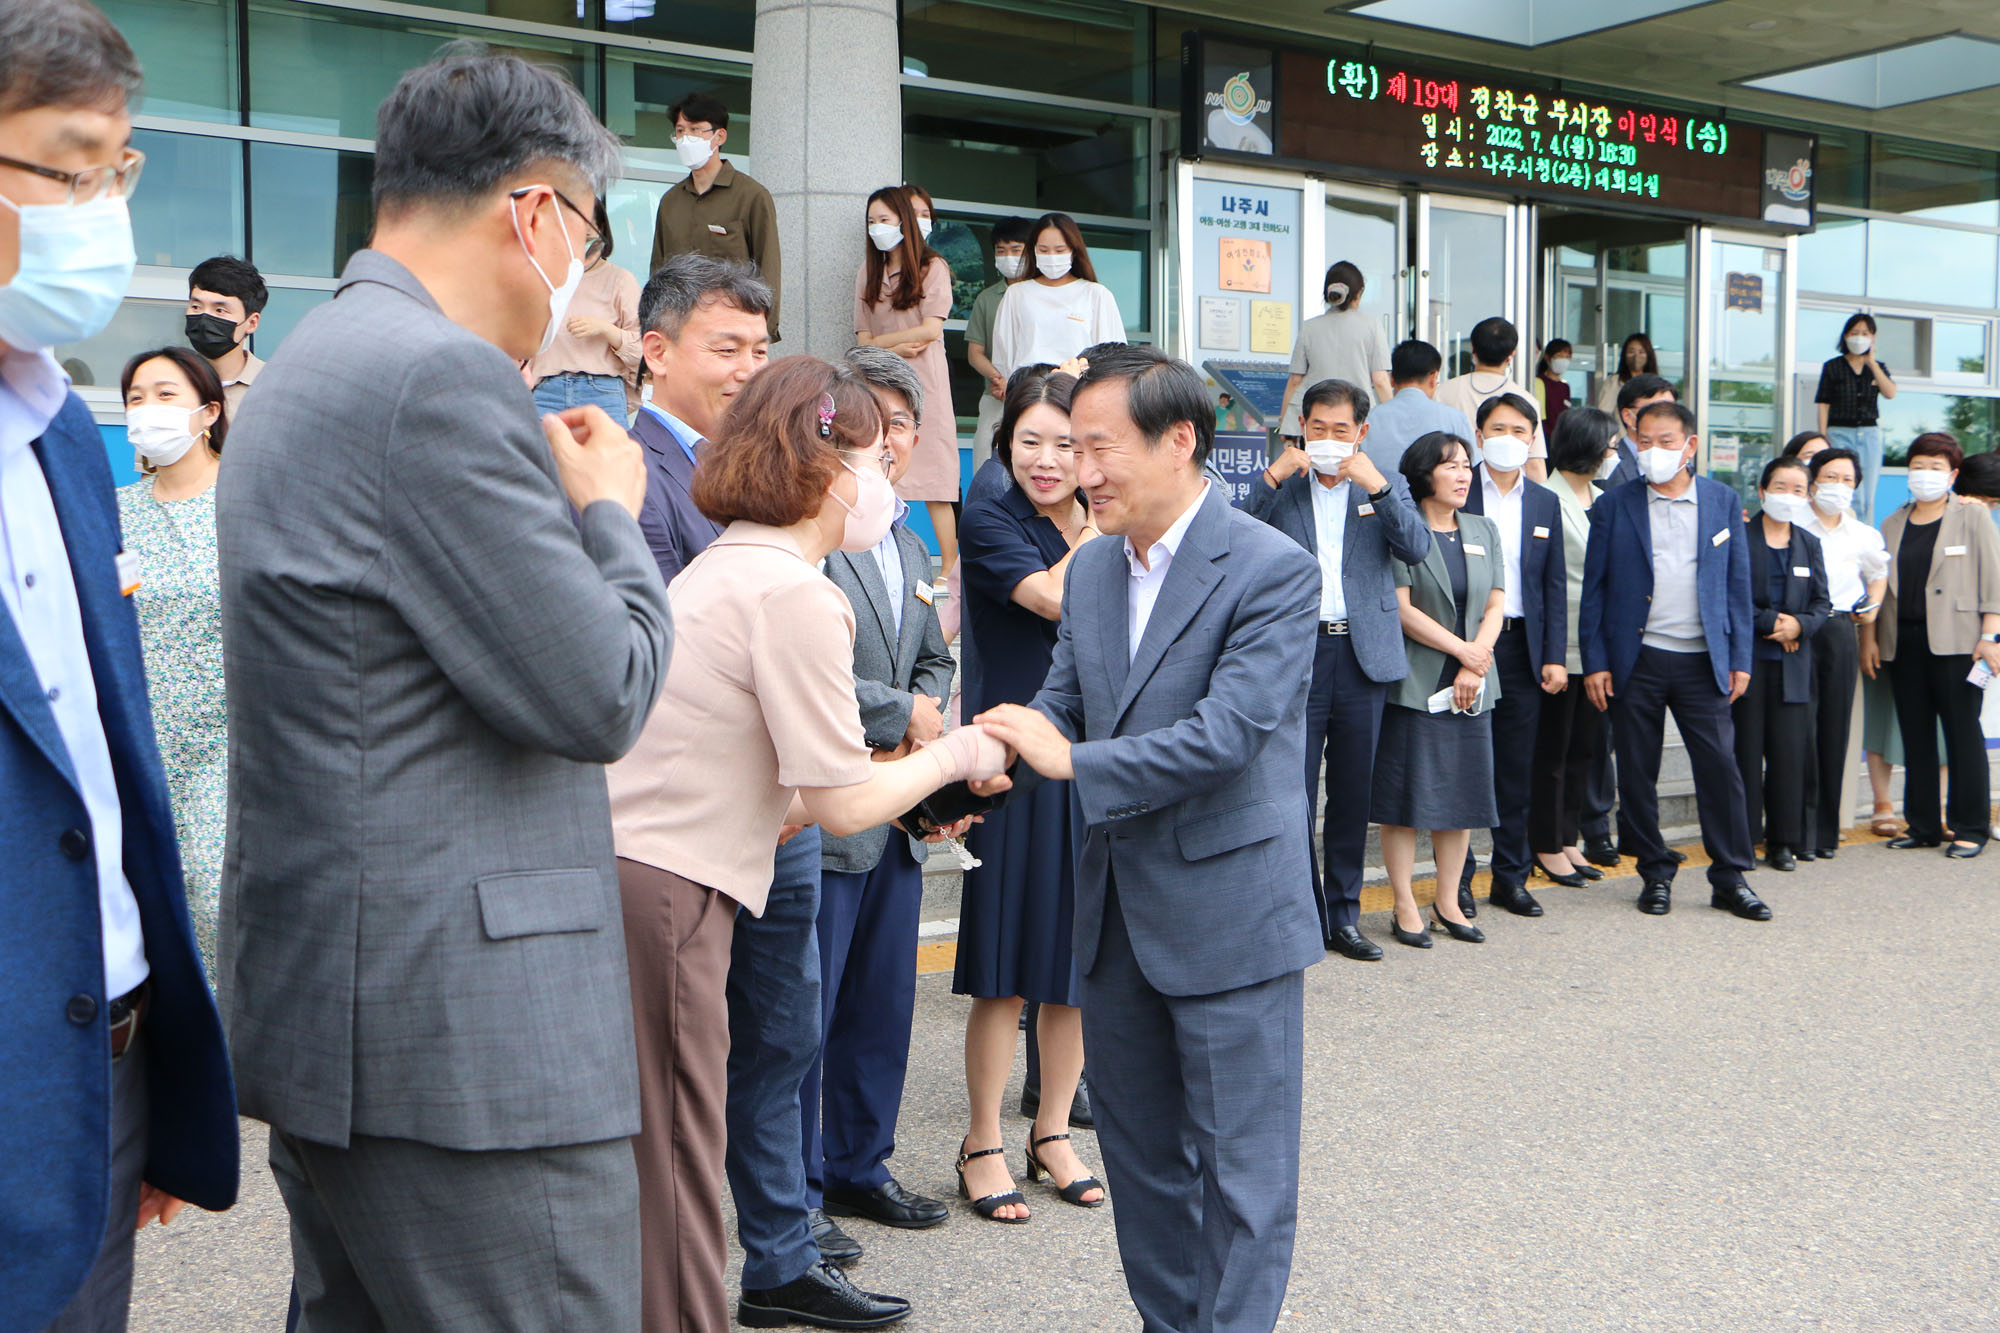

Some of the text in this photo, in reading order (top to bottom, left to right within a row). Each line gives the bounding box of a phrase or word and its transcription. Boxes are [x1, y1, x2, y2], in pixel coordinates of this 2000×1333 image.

[1327, 58, 1379, 100] (환)
[1547, 99, 1613, 138] 부시장
[1617, 109, 1678, 146] 이임식
[1686, 118, 1728, 155] (송)
[1222, 195, 1269, 217] 나주시
